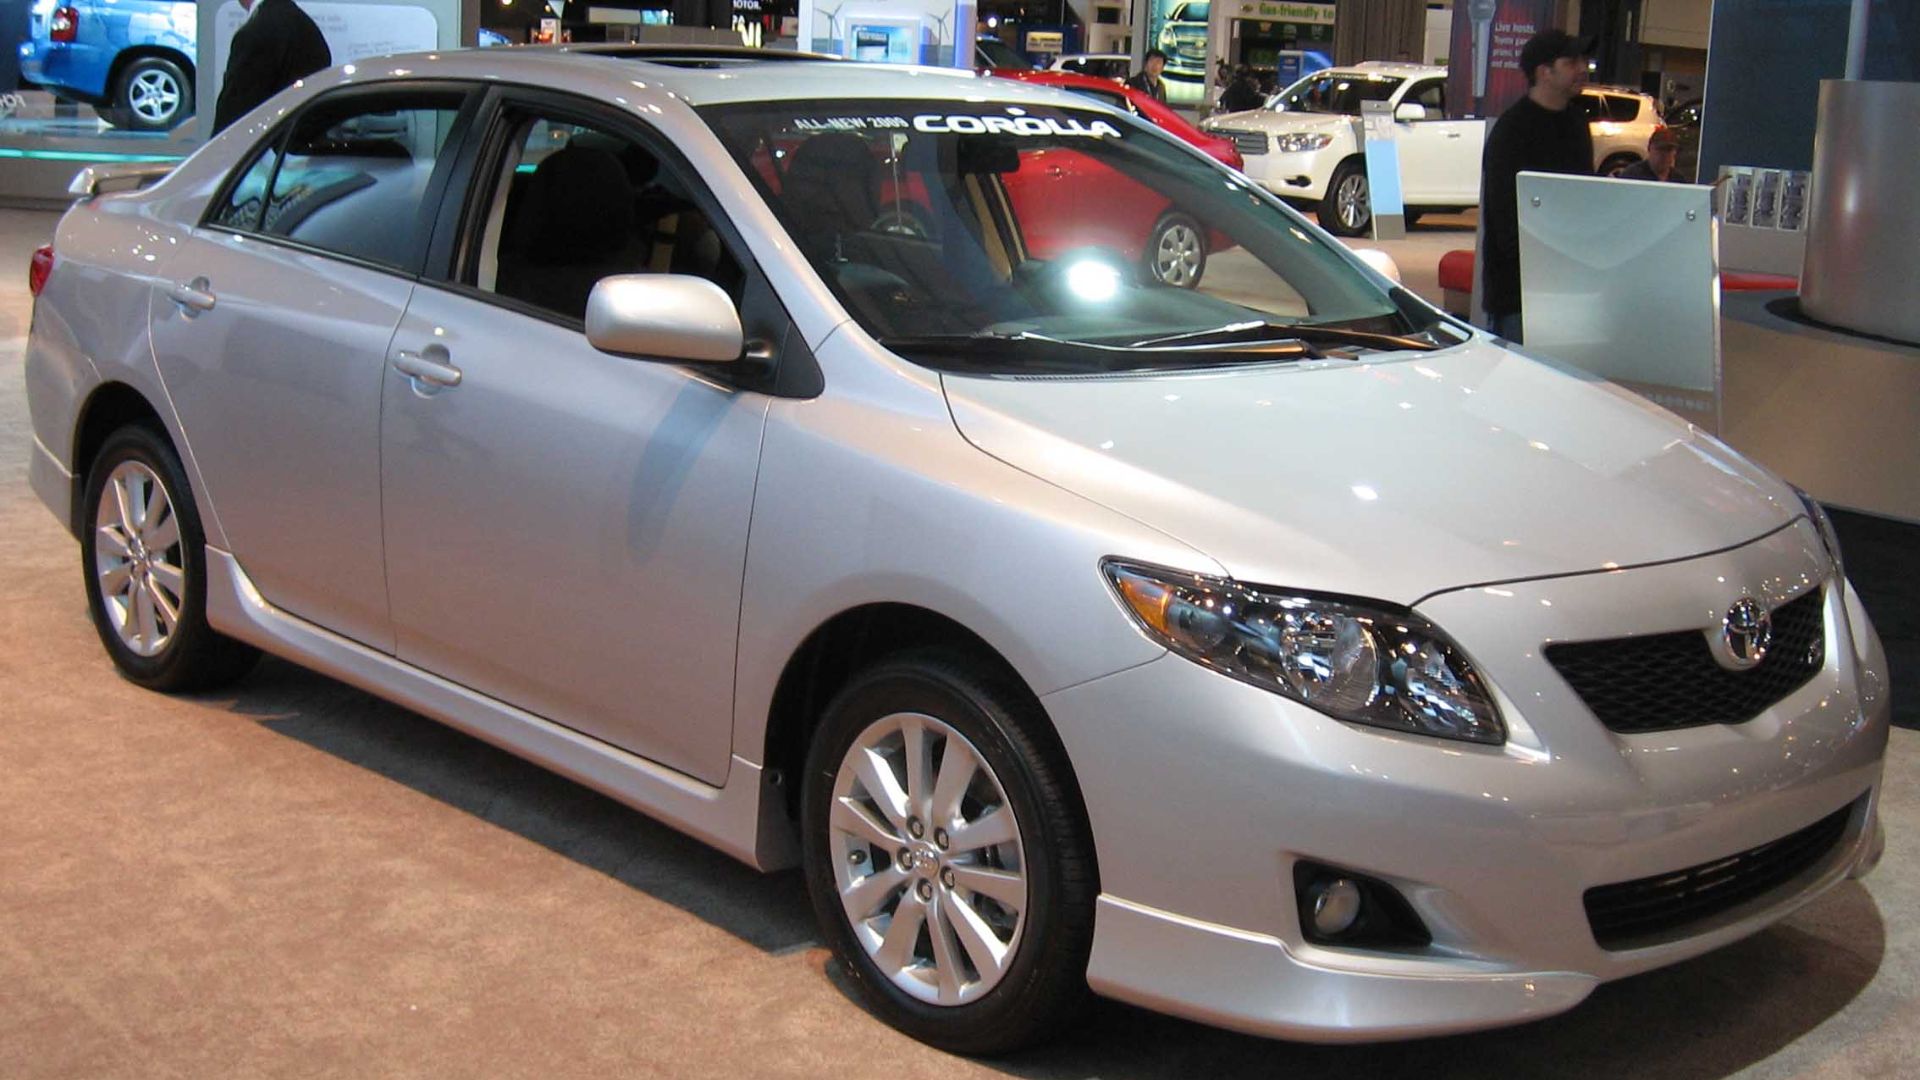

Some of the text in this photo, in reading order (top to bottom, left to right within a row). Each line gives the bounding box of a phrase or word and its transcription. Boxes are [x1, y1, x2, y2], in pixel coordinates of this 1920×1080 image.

[794, 115, 1122, 138] ALL-NEW 2009 COROLLA
